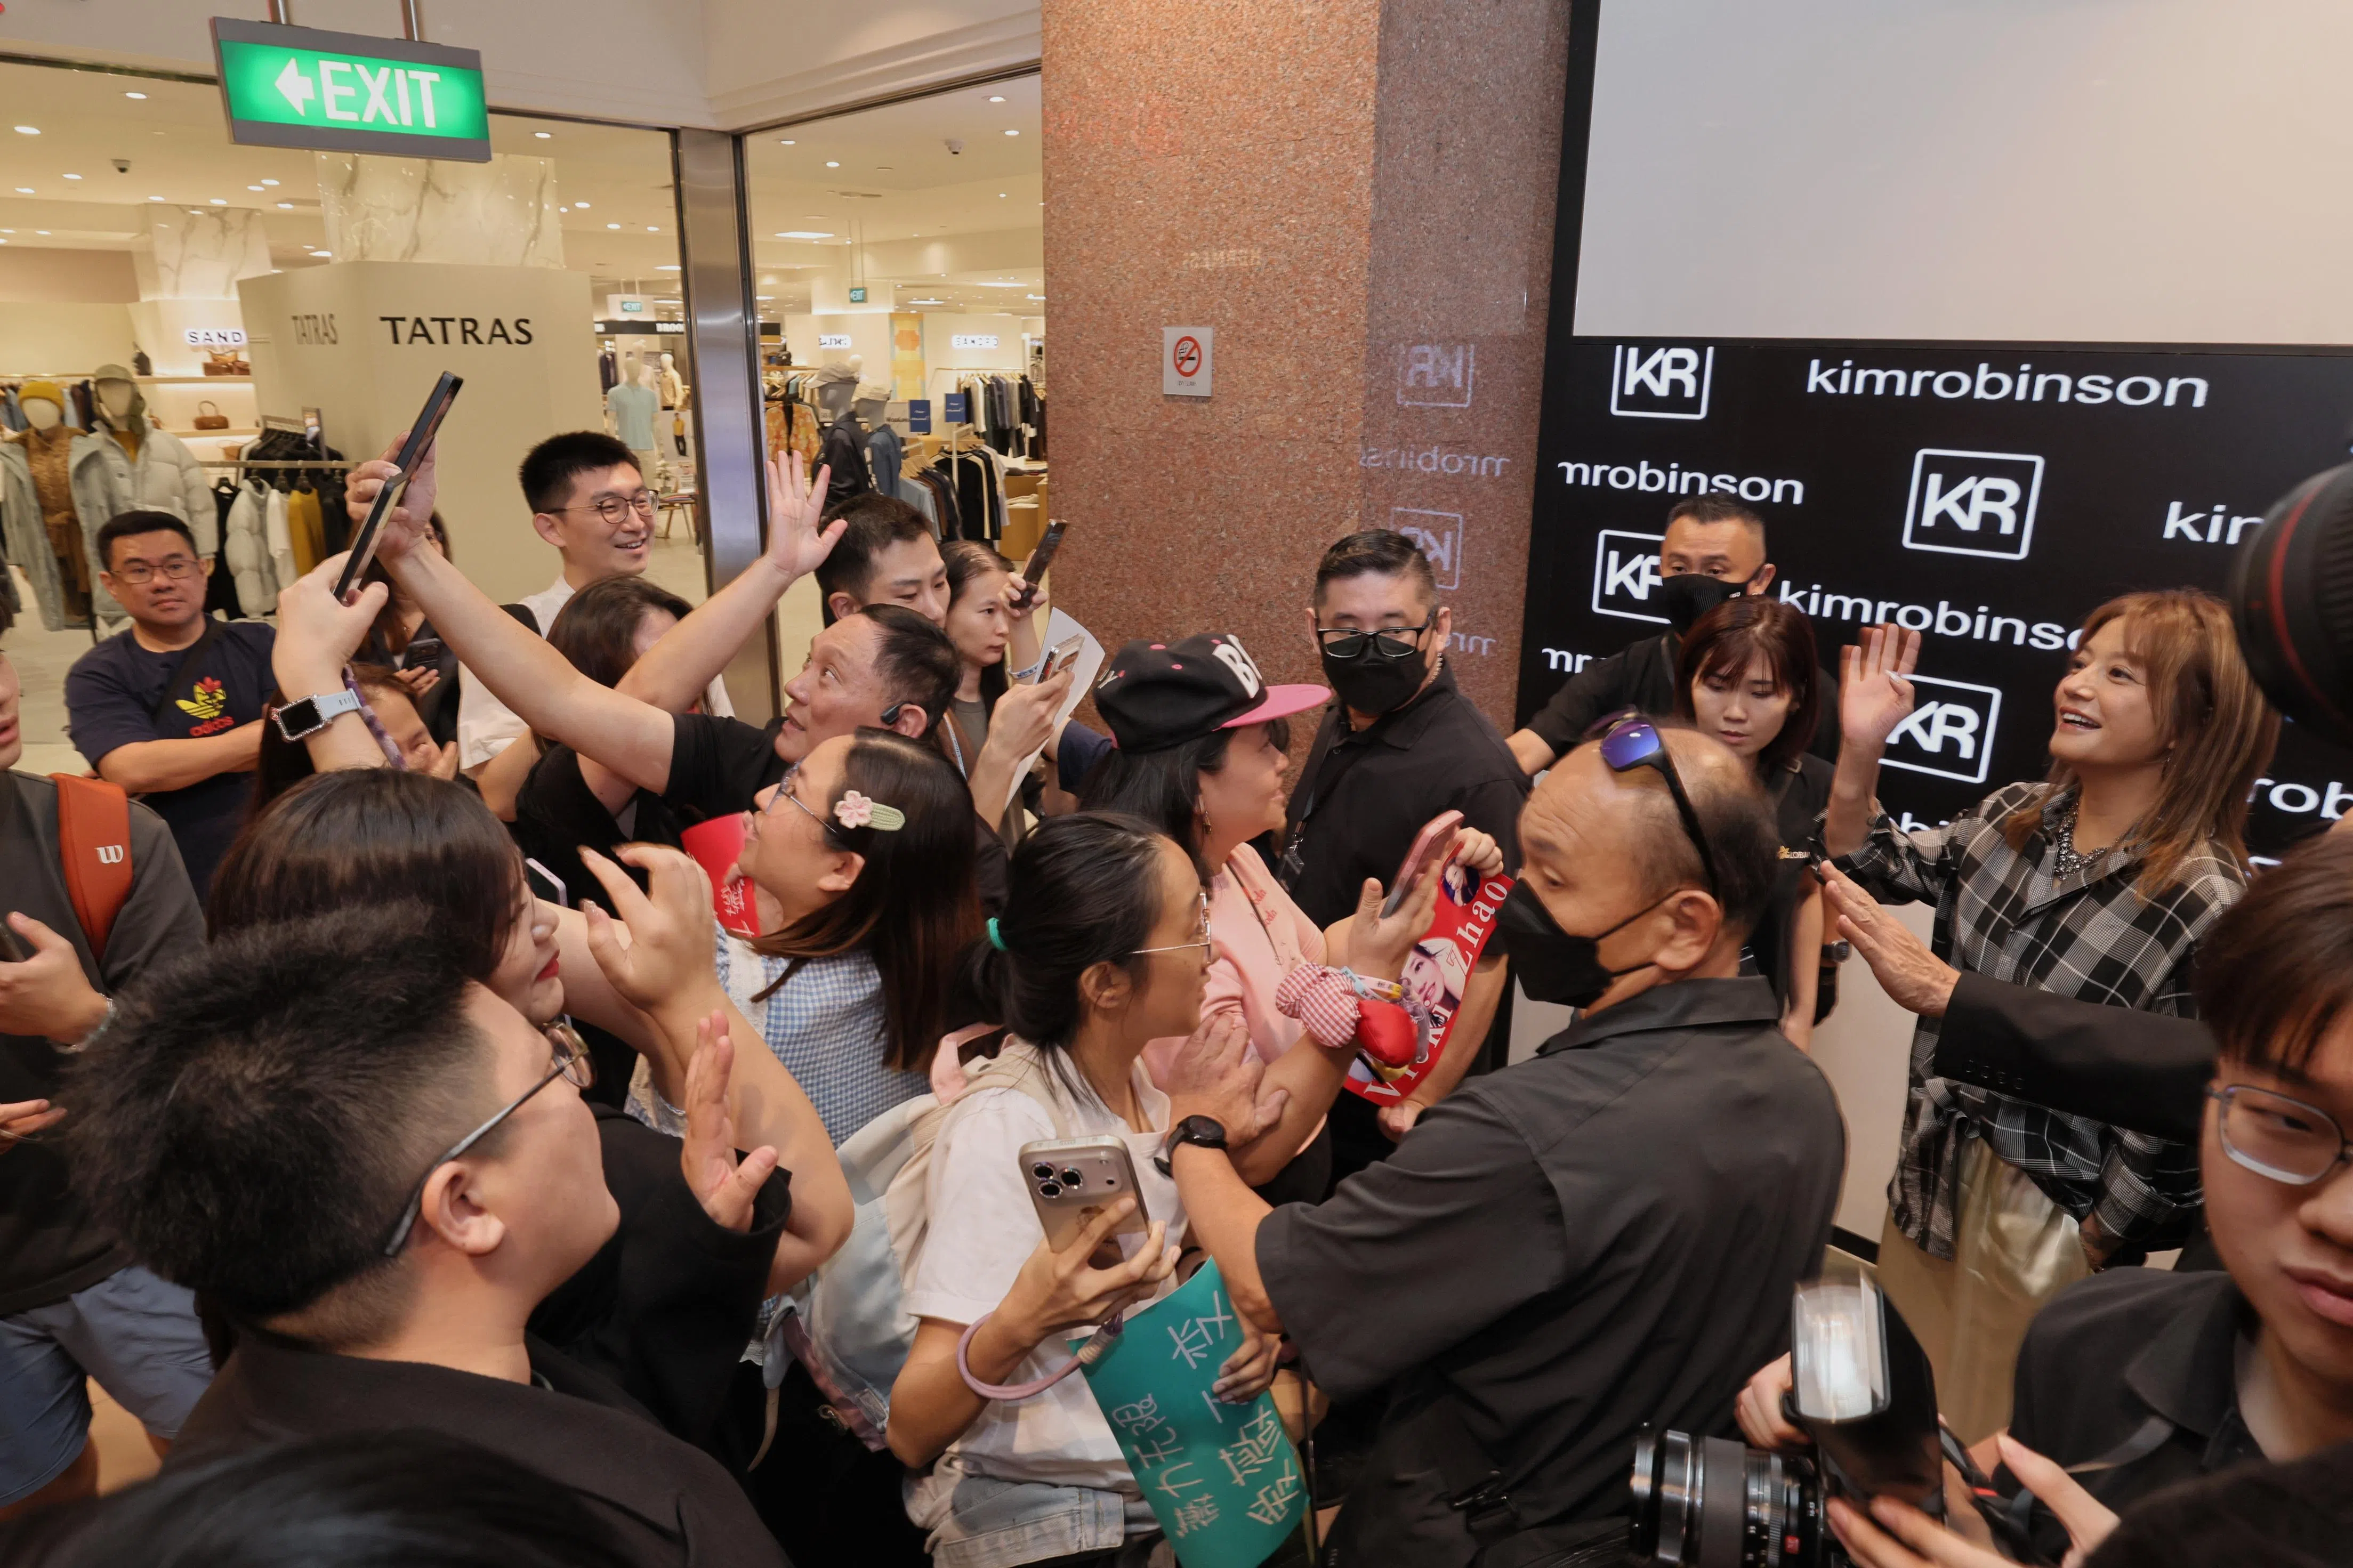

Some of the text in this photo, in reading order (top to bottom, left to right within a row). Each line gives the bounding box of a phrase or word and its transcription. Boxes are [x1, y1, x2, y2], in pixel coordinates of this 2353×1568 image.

[319, 60, 441, 128] EXIT
[189, 331, 242, 343] SAND
[291, 313, 337, 345] TATRAS
[380, 317, 532, 345] TATRAS
[1624, 347, 1699, 398] KR
[1807, 359, 2209, 408] kimrobinson
[1921, 473, 2021, 535] KR
[1446, 882, 1508, 976] Zhao
